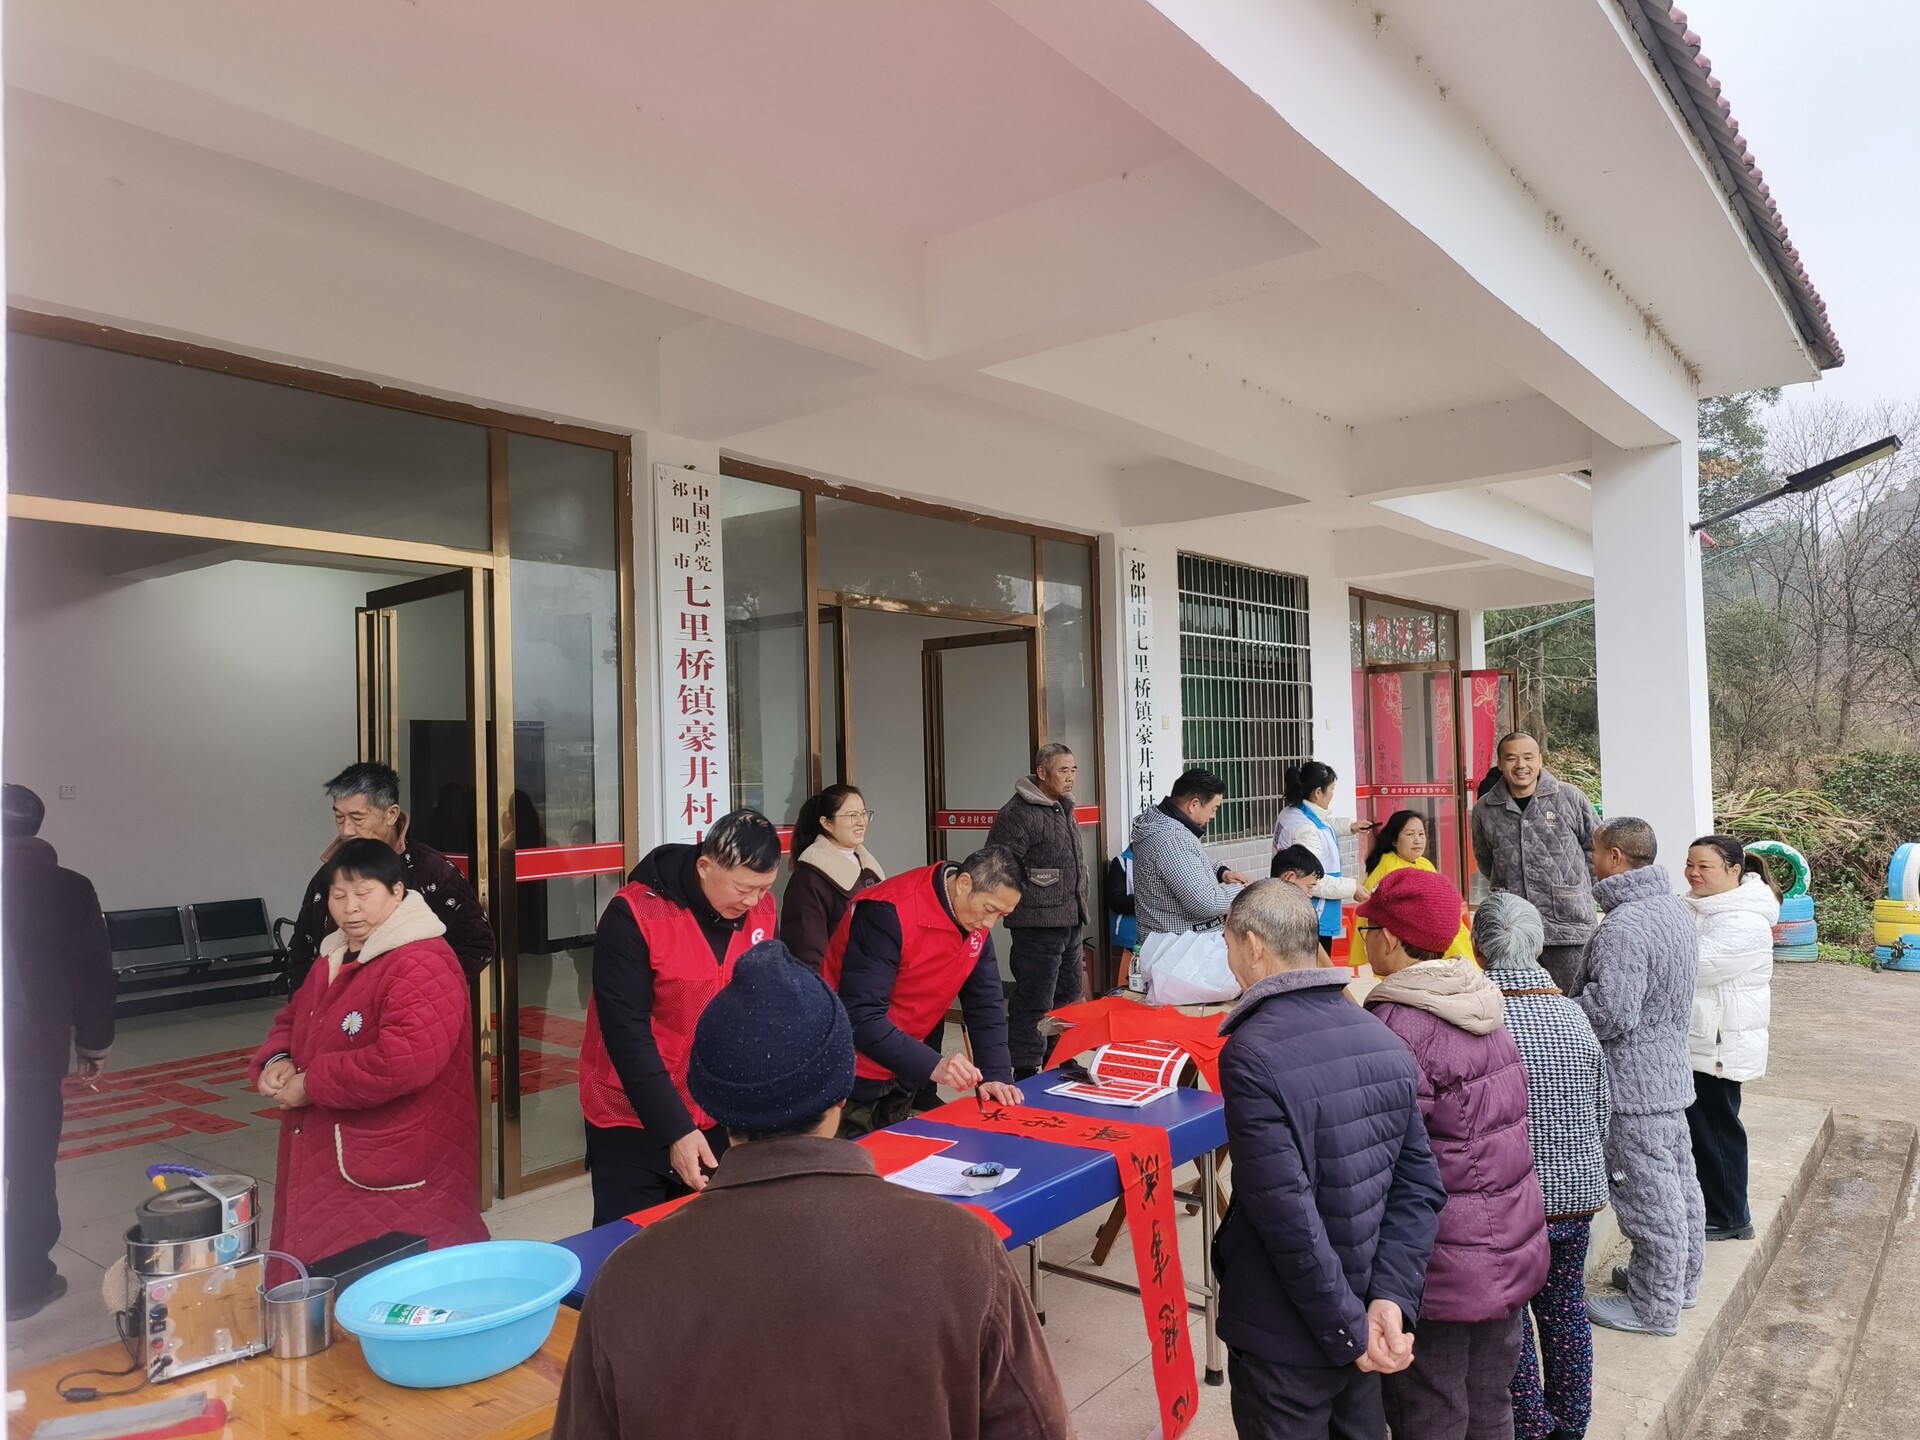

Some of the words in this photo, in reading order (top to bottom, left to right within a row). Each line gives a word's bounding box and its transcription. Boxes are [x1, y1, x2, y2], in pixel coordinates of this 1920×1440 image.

[671, 479, 691, 570] 祁阳市
[692, 484, 713, 573] 中国共产党
